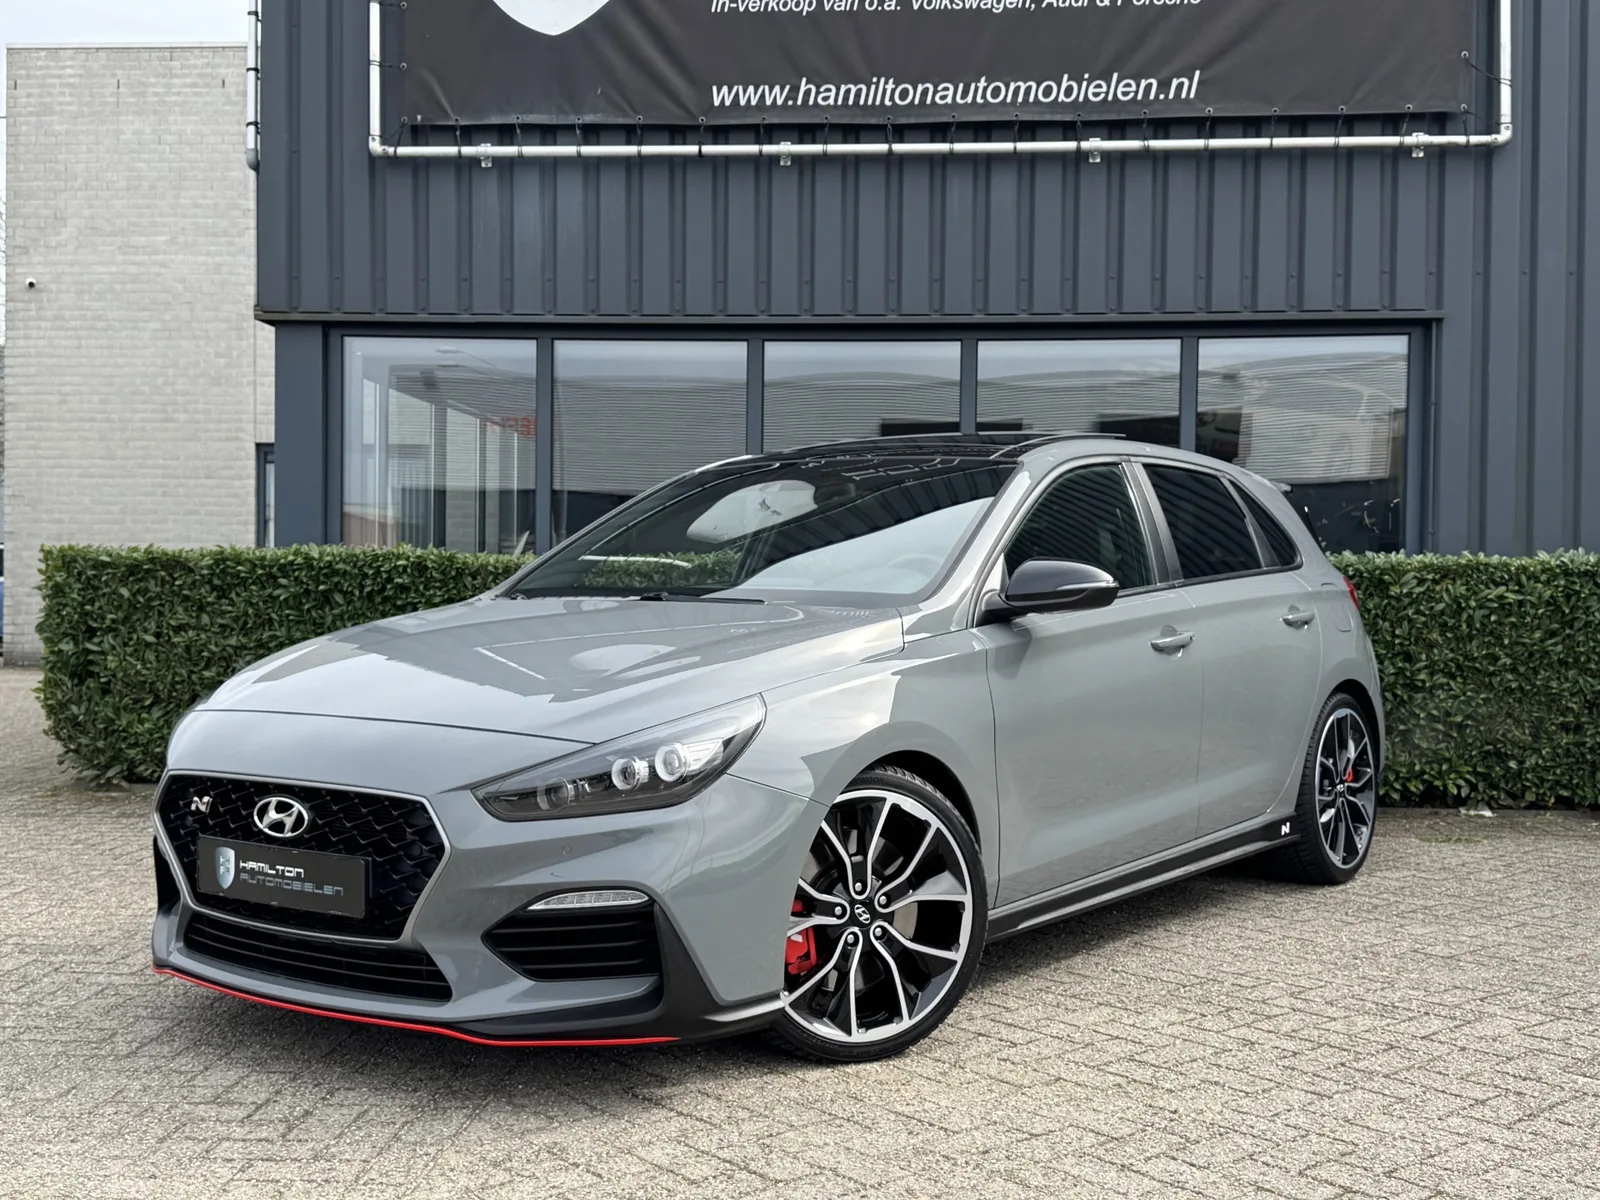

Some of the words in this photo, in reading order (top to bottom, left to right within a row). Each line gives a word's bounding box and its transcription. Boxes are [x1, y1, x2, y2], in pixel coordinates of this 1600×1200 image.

[711, 0, 816, 16] In-verkoop
[823, 0, 858, 11] van
[865, 0, 901, 10] o.a.
[711, 70, 1200, 107] www.hamiltonautomobielen.nl
[1281, 821, 1291, 836] N
[240, 860, 304, 878] HAMILTON
[240, 873, 344, 896] AUTOMOBIELEN
